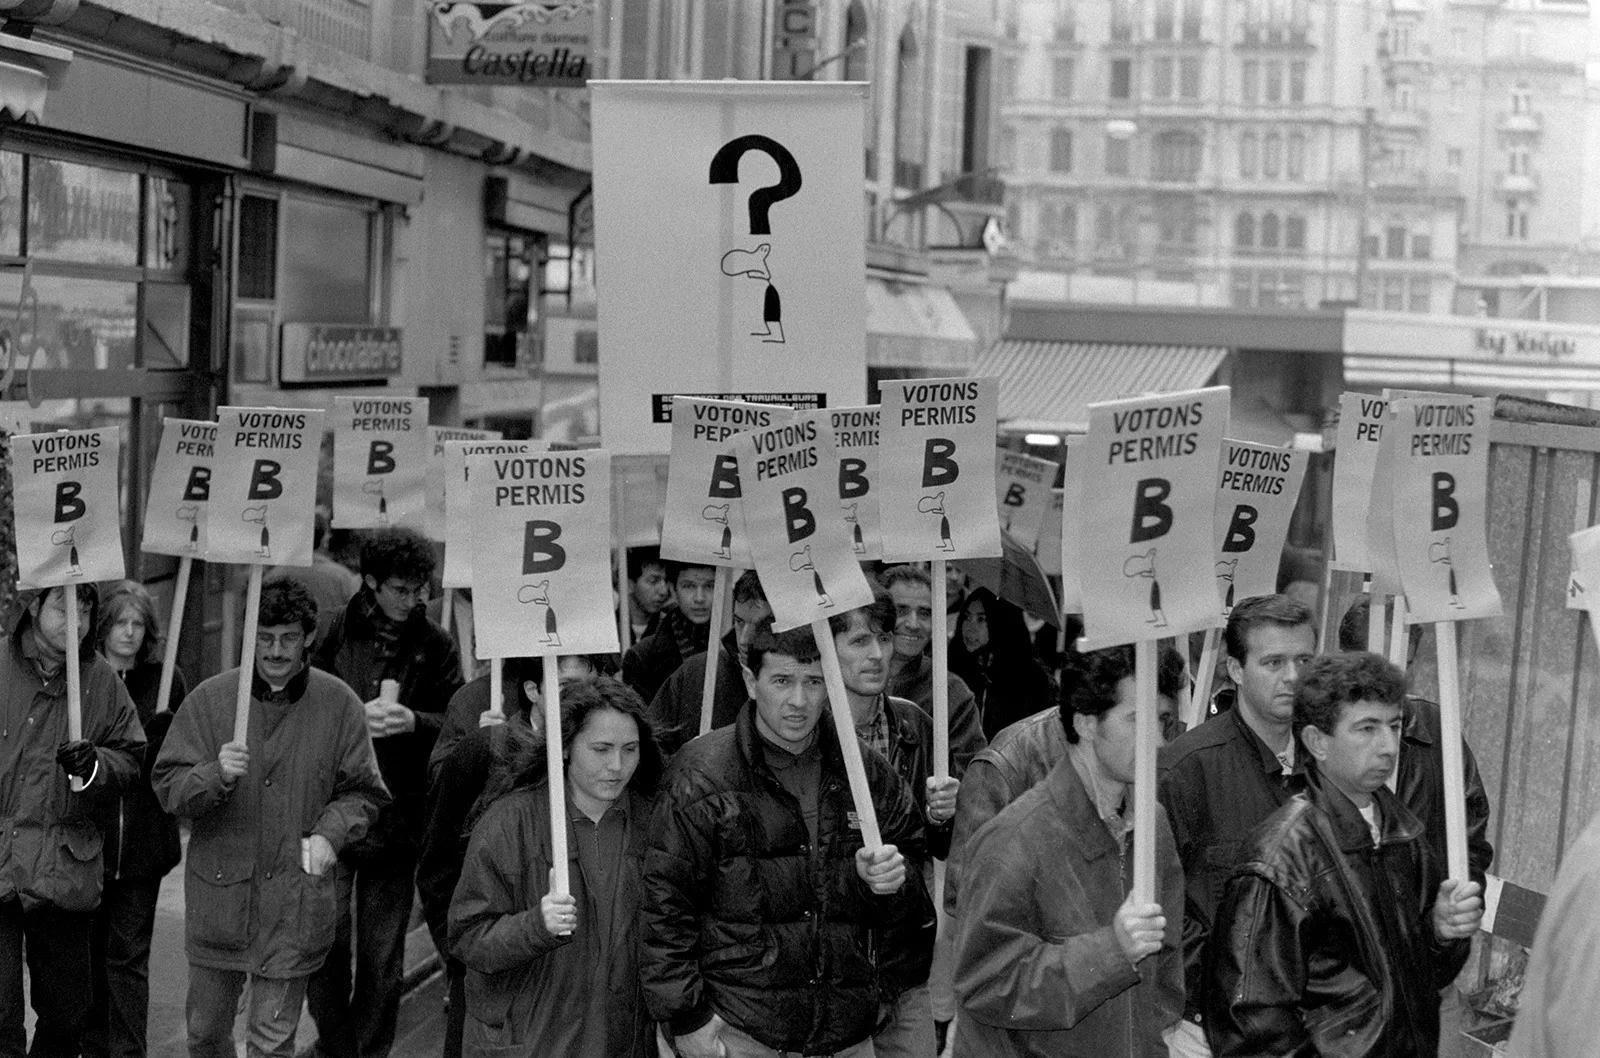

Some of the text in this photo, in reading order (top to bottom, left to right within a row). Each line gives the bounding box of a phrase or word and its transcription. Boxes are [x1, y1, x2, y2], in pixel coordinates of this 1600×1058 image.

[464, 44, 587, 83] Castella
[352, 401, 412, 416] VOTONS
[903, 382, 978, 403] VOTONS
[238, 413, 306, 429] VOTONS
[352, 418, 410, 432] PERMIS
[694, 404, 770, 427] VOTONS
[901, 405, 976, 427] PERMIS
[1113, 402, 1203, 434] VOTONS
[1414, 404, 1475, 427] VOTONS
[32, 433, 101, 454] VOTONS
[234, 432, 302, 449] PERMIS
[752, 420, 817, 454] VOTONS
[1108, 432, 1198, 465] PERMIS
[1411, 433, 1472, 456] PERMIS
[33, 452, 99, 474] PERMIS
[367, 440, 396, 476] B
[494, 457, 586, 480] VOTONS
[756, 446, 818, 481] PERMIS
[922, 438, 959, 488] B
[1228, 447, 1291, 473] VOTONS
[182, 466, 212, 500] B
[248, 459, 283, 500] B
[708, 454, 742, 499] B
[838, 458, 870, 499] B
[1220, 471, 1285, 495] PERMIS
[54, 481, 86, 523] B
[495, 483, 585, 507] PERMIS
[1003, 483, 1025, 507] B
[1129, 477, 1173, 544] B
[1431, 471, 1459, 532] B
[782, 487, 816, 544] B
[1221, 504, 1258, 552] B
[522, 520, 566, 576] B
